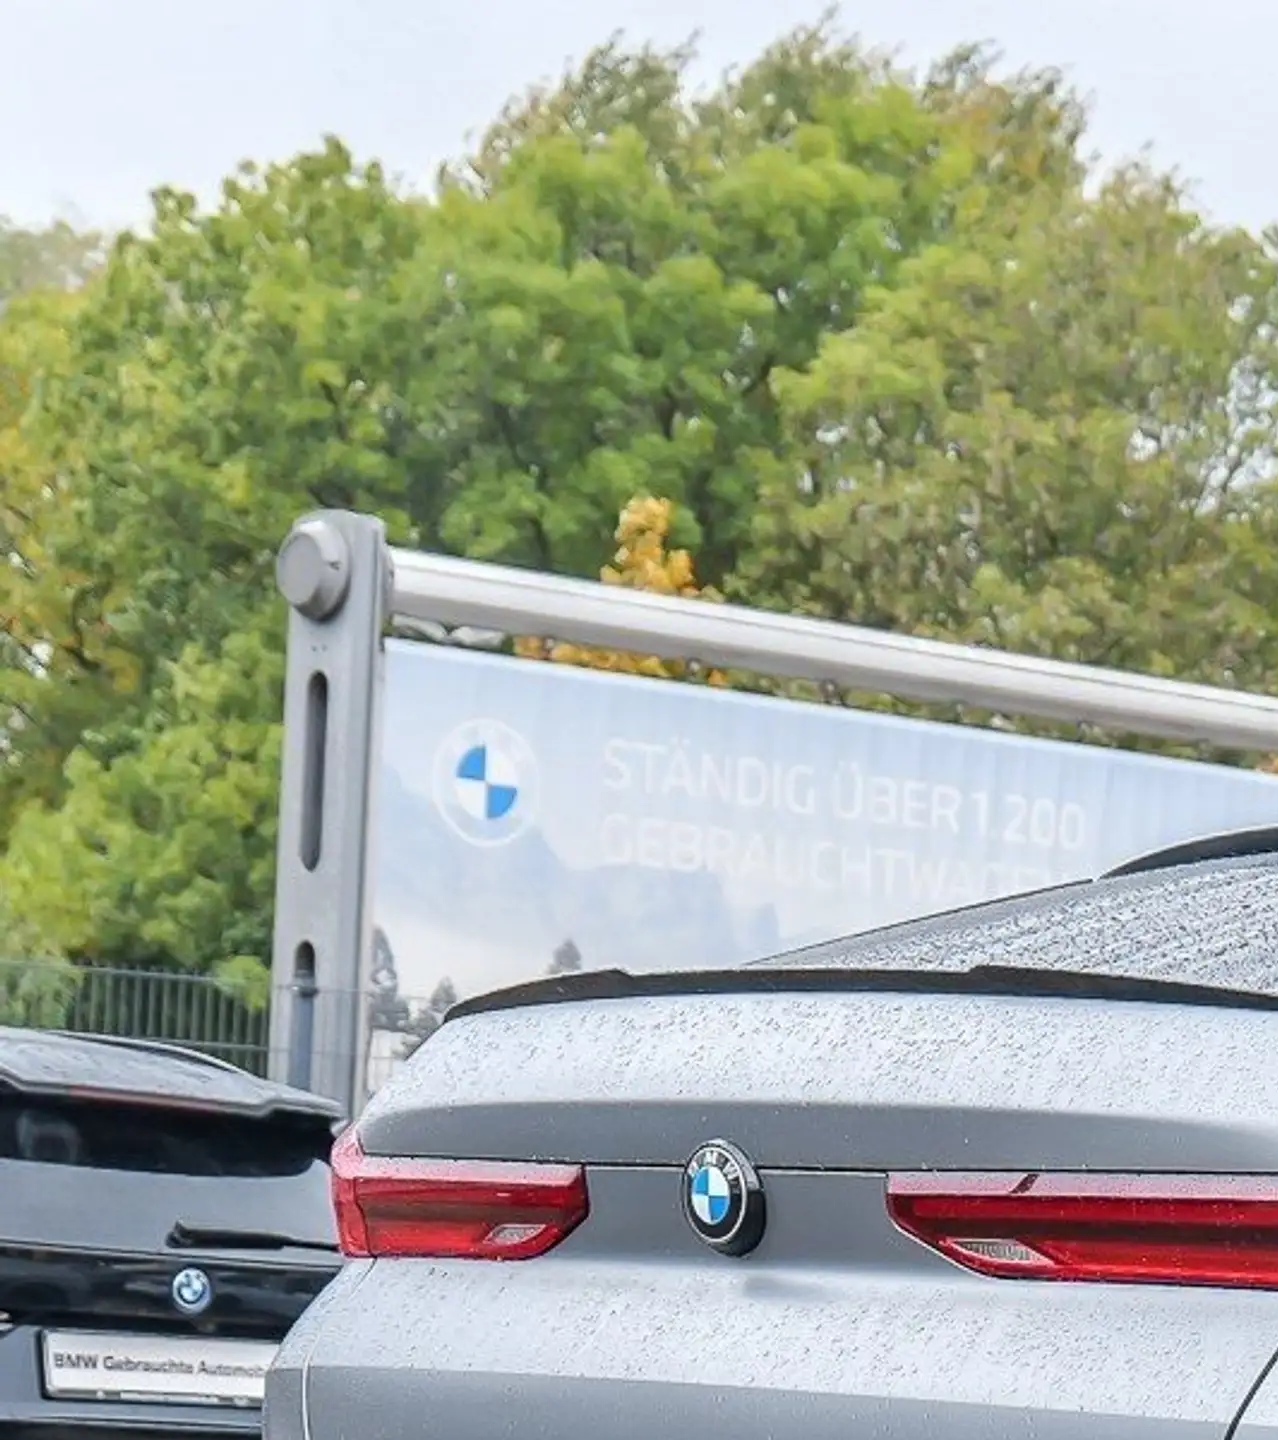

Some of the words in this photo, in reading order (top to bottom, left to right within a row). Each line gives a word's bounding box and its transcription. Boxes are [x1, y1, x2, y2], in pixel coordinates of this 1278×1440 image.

[602, 736, 815, 815] STÄNDIG
[832, 760, 962, 834] ÜBER
[689, 1149, 741, 1183] BMW
[53, 1352, 98, 1370] BMW
[103, 1355, 193, 1375] Gebrauchte
[197, 1360, 267, 1378] Automob
